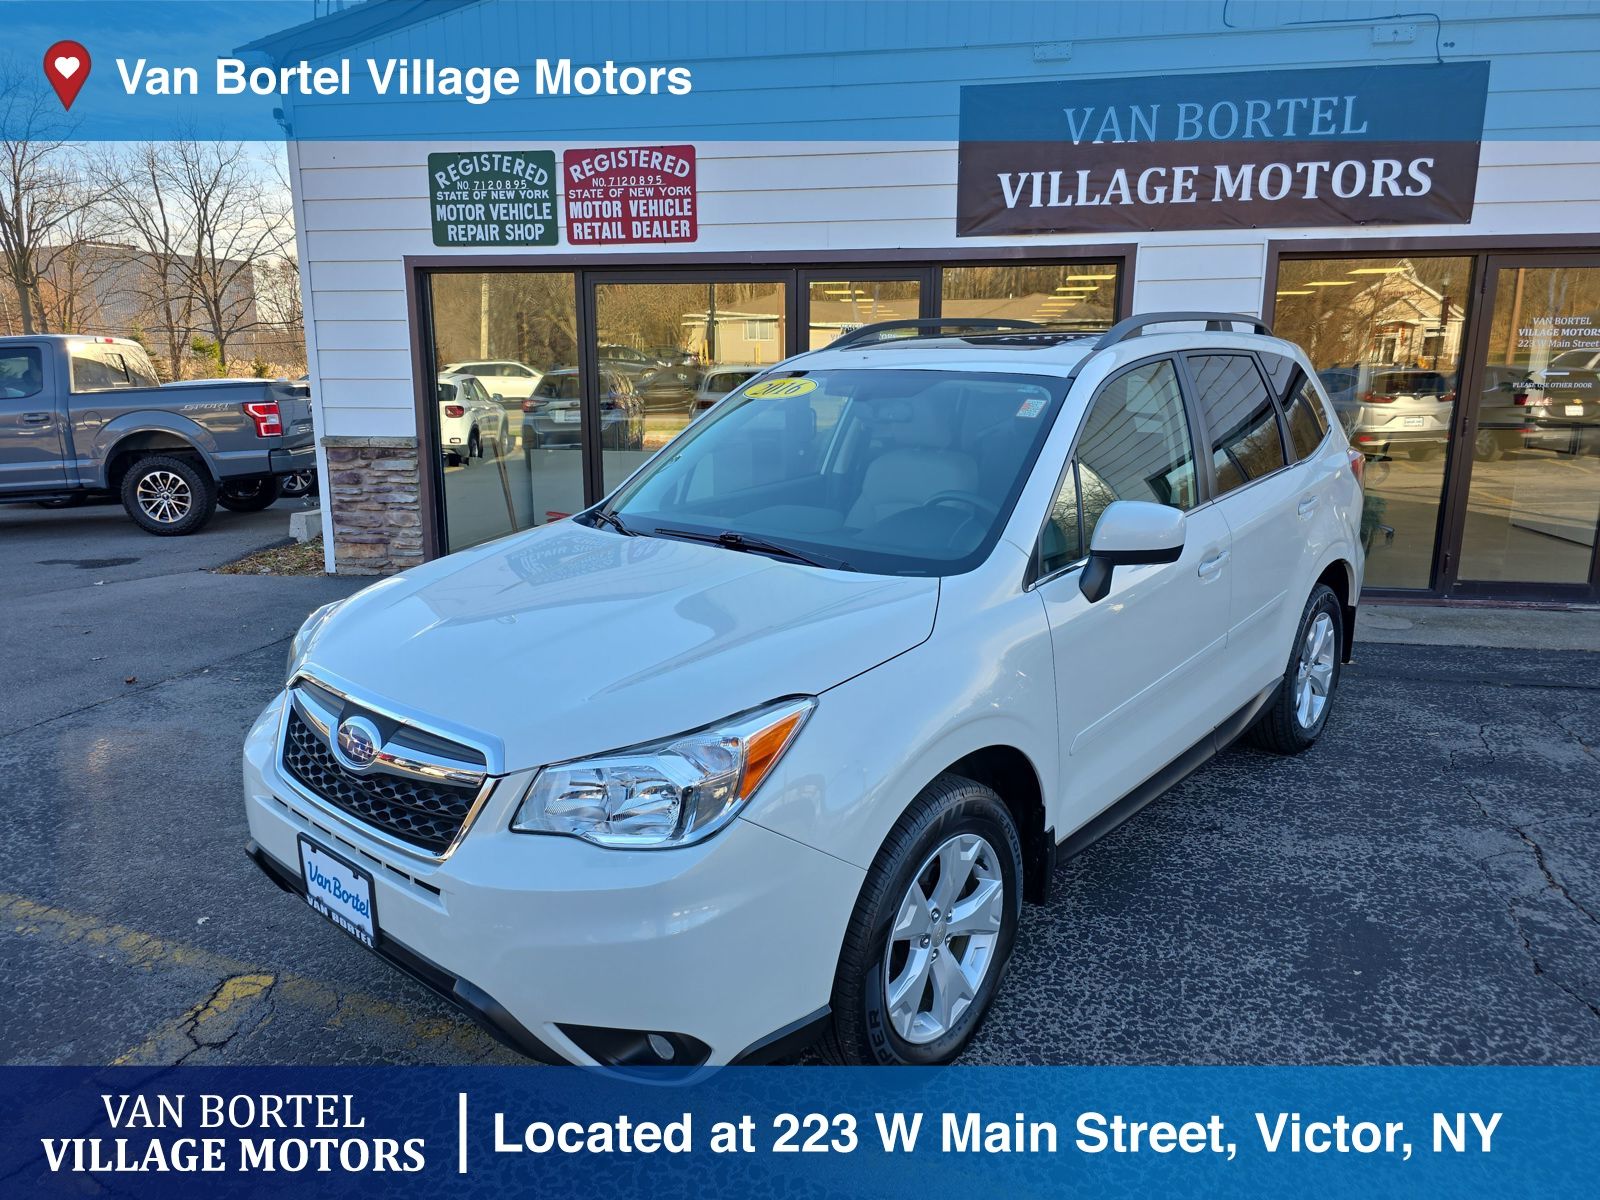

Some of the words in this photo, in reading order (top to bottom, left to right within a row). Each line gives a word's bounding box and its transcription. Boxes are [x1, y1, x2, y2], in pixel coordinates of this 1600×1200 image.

[1064, 104, 1160, 145] VAN
[1175, 95, 1368, 141] BORTEL
[434, 153, 549, 189] REGISTERED
[569, 149, 690, 183] REGISTERED
[457, 181, 471, 190] NO.
[473, 180, 527, 190] 7120895
[592, 177, 607, 187] NO.
[608, 175, 662, 186] 7120895
[997, 166, 1199, 209] VILLAGE
[1211, 157, 1435, 202] MOTORS
[436, 191, 470, 200] STATE
[473, 190, 488, 200] OF
[491, 190, 515, 200] NEW
[519, 189, 550, 199] YORK
[568, 188, 604, 199] STATE
[609, 188, 624, 198] OF
[629, 187, 654, 197] NEW
[659, 186, 692, 196] YORK
[435, 203, 486, 221] MOTOR
[489, 202, 553, 221] VEHICLE
[569, 200, 623, 219] MOTOR
[629, 198, 693, 218] VEHICLE
[447, 224, 500, 241] REPAIR
[505, 223, 545, 241] SHOP
[573, 221, 626, 240] RETAIL
[632, 220, 691, 239] DEALER
[1533, 317, 1553, 325] VAN
[1555, 317, 1592, 325] BORTEL
[1518, 328, 1560, 337] VILLAGE
[1561, 327, 1600, 337] MOTORS
[1549, 340, 1570, 348] Main
